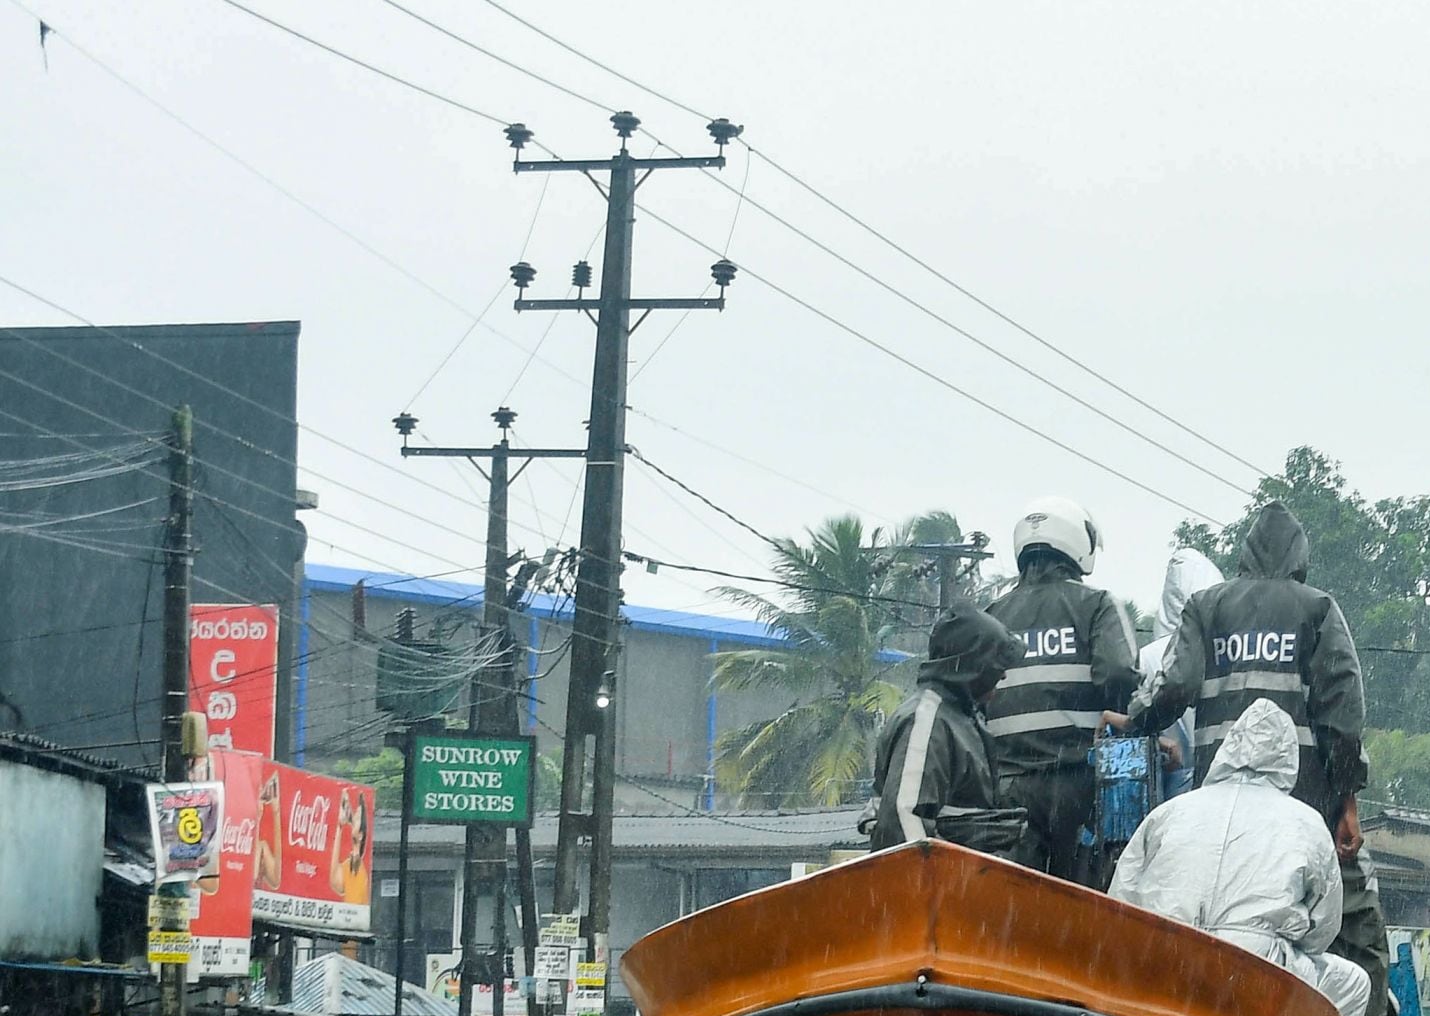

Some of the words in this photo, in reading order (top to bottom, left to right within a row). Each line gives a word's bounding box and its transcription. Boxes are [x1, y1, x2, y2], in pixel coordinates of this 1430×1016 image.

[1010, 627, 1077, 659] LICE
[1213, 632, 1297, 666] POLICE
[422, 745, 522, 766] SUNROW
[438, 770, 502, 789] WINE
[424, 792, 515, 812] STORES
